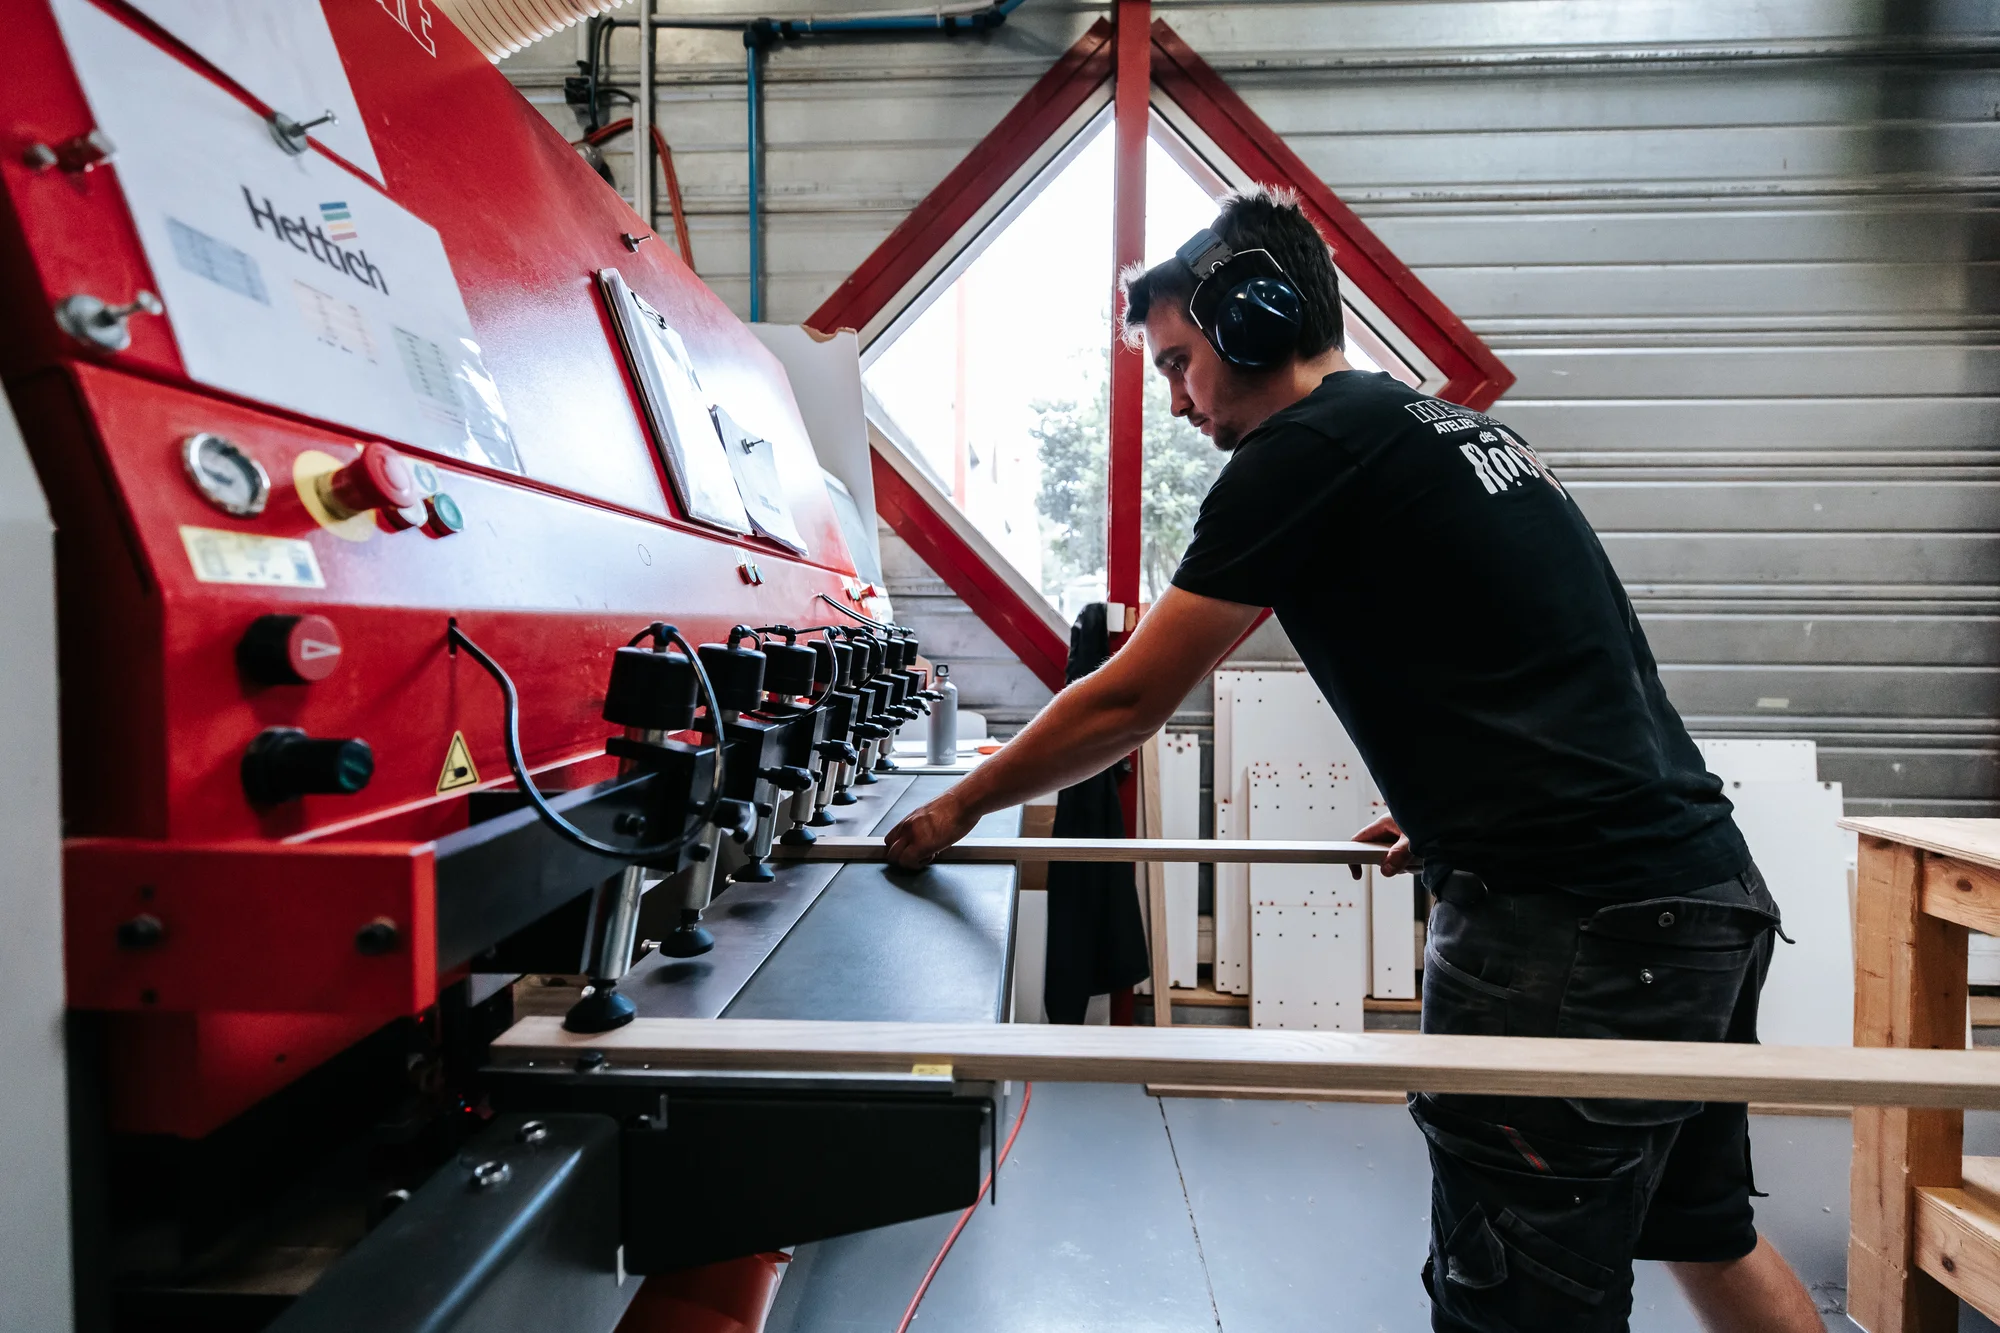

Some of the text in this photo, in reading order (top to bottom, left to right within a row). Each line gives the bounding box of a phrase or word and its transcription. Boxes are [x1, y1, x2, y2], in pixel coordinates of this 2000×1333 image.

[240, 184, 390, 296] Hettich
[1433, 417, 1480, 435] ATELIER
[1479, 430, 1498, 444] des
